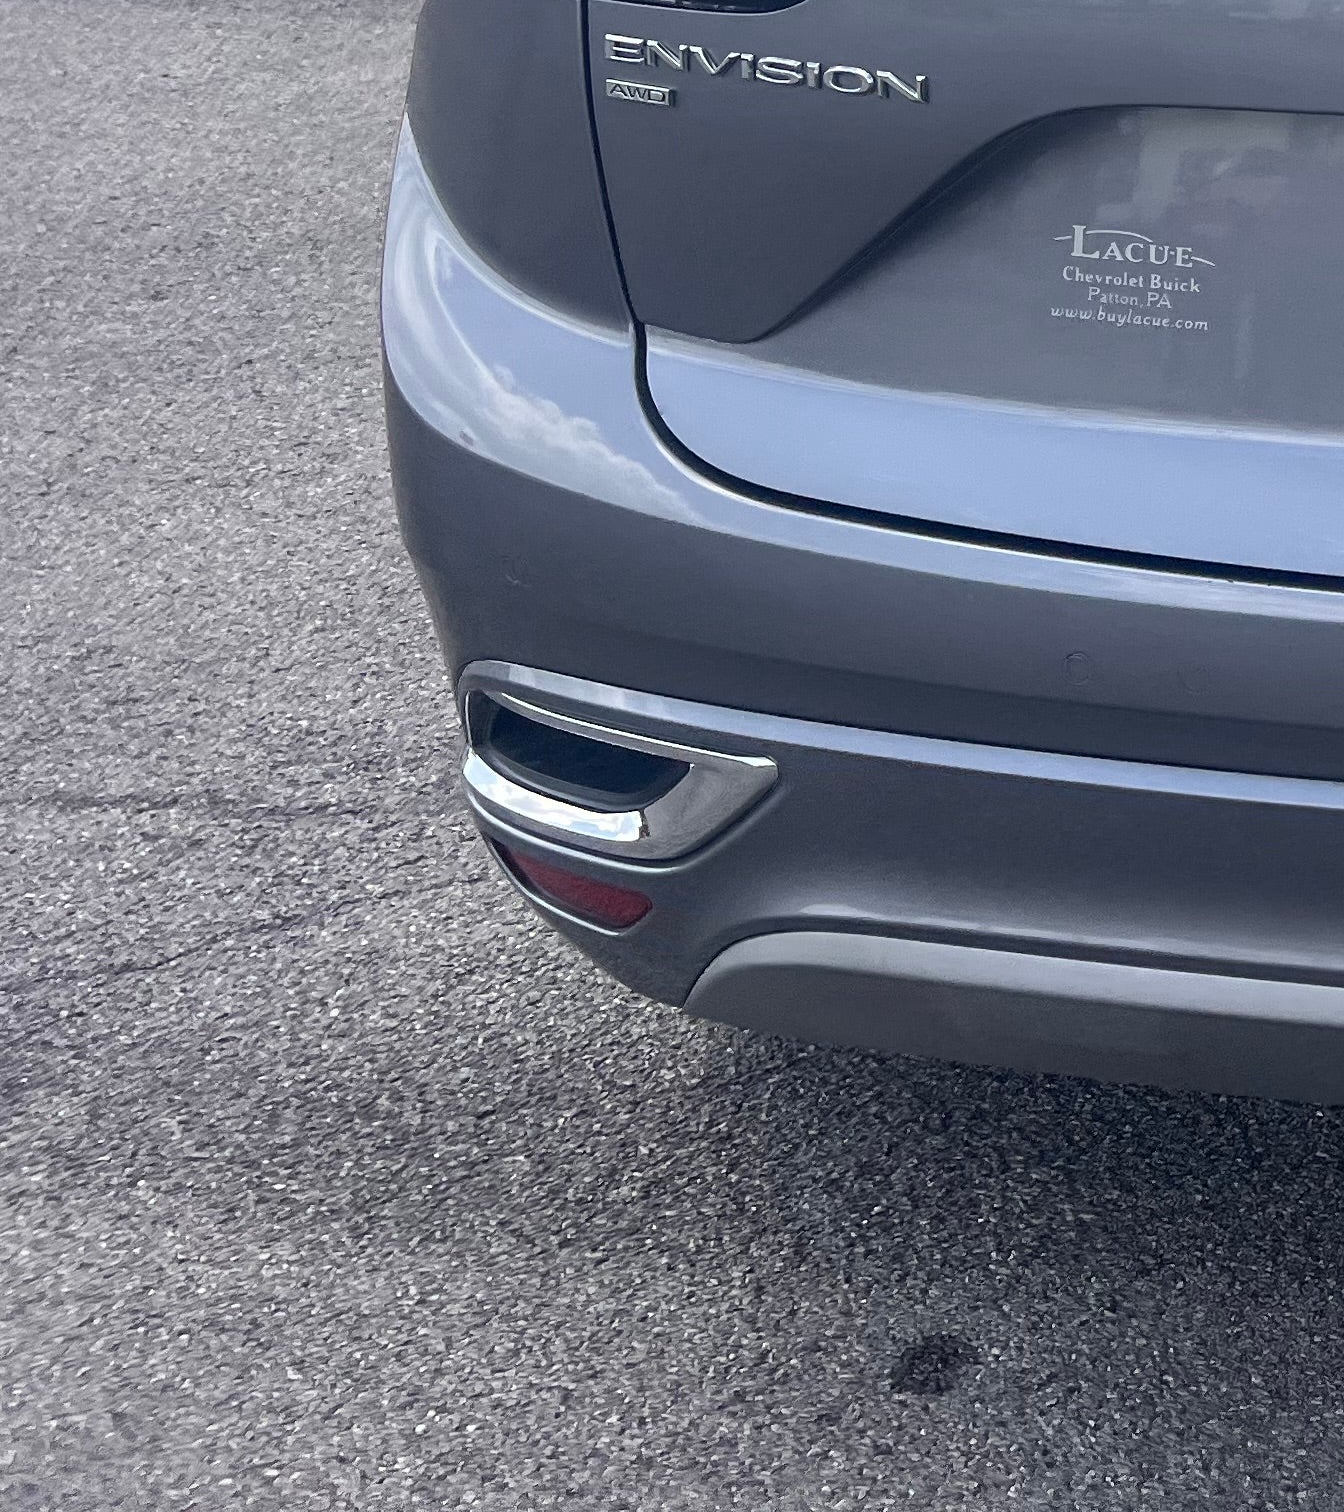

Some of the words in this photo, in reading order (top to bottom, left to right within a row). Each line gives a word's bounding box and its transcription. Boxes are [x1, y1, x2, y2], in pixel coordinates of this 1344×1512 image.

[604, 33, 931, 104] ENVISION
[608, 81, 667, 103] AWD
[1062, 265, 1144, 288] Chevrolet
[1150, 273, 1201, 293] Buick
[1147, 292, 1172, 309] PA
[1050, 306, 1208, 331] www.buylacue.com
